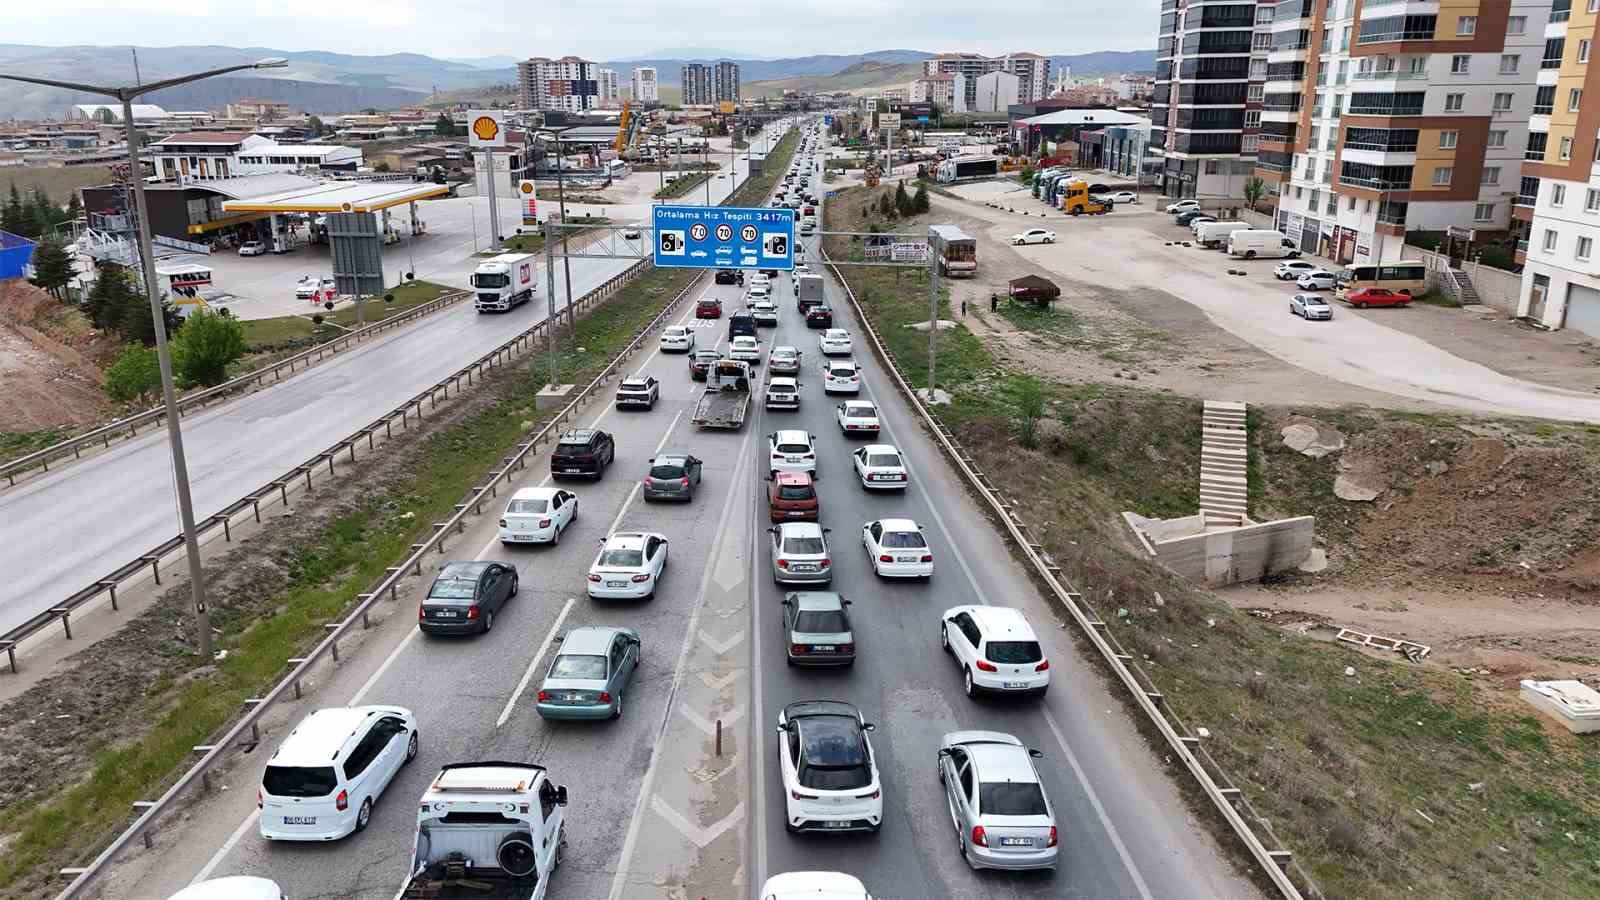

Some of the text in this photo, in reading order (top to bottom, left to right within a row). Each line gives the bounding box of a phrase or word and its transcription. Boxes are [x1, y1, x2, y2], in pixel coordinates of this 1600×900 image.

[656, 210, 700, 219] Ortalama
[723, 212, 752, 221] Tespiti
[756, 213, 791, 222] 3417m
[693, 227, 705, 236] 70
[719, 228, 729, 237] 70
[744, 229, 755, 239] 70
